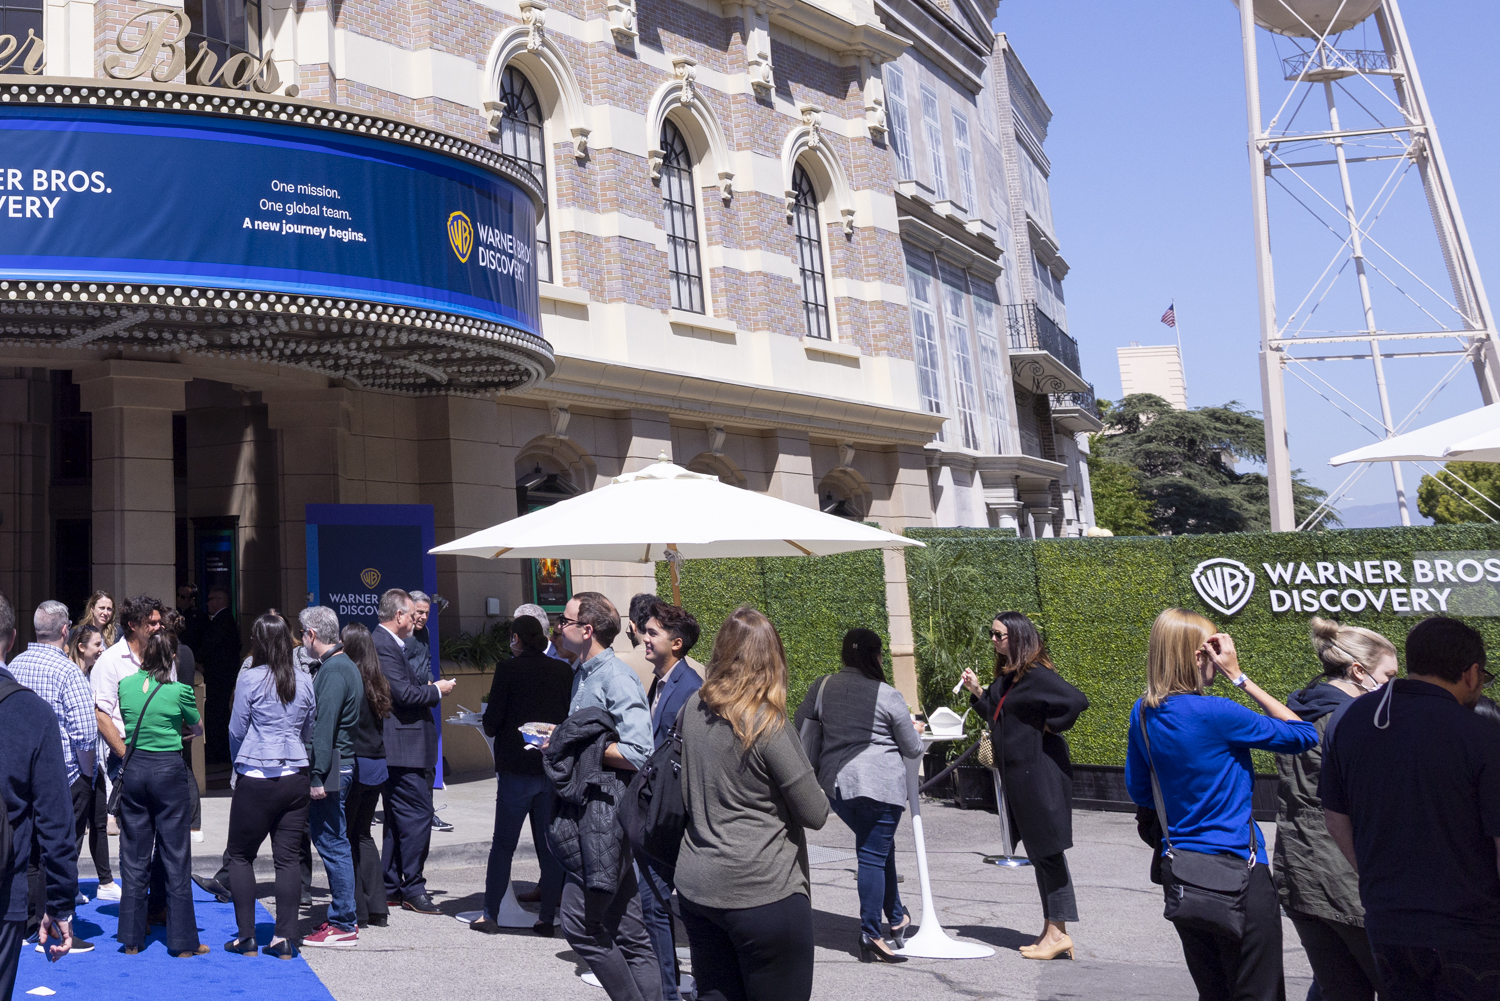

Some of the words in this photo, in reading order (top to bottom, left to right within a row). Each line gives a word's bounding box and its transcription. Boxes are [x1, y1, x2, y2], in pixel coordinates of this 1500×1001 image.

[103, 7, 300, 98] Bros.
[33, 169, 113, 194] BROS.
[271, 179, 295, 193] One
[297, 183, 341, 199] mission.
[259, 198, 283, 212] One
[285, 201, 320, 216] global
[322, 205, 352, 220] team.
[242, 217, 253, 229] A
[254, 219, 280, 232] new
[281, 219, 328, 239] journey
[329, 225, 367, 242] begins.
[450, 219, 470, 255] WB
[476, 222, 517, 256] WARNER
[478, 246, 525, 283] DISCOVERY
[363, 571, 378, 585] WB
[1262, 559, 1407, 586] WARNER
[329, 593, 379, 604] WARNER
[1199, 566, 1247, 607] WB
[1269, 588, 1452, 613] DISCOVERY
